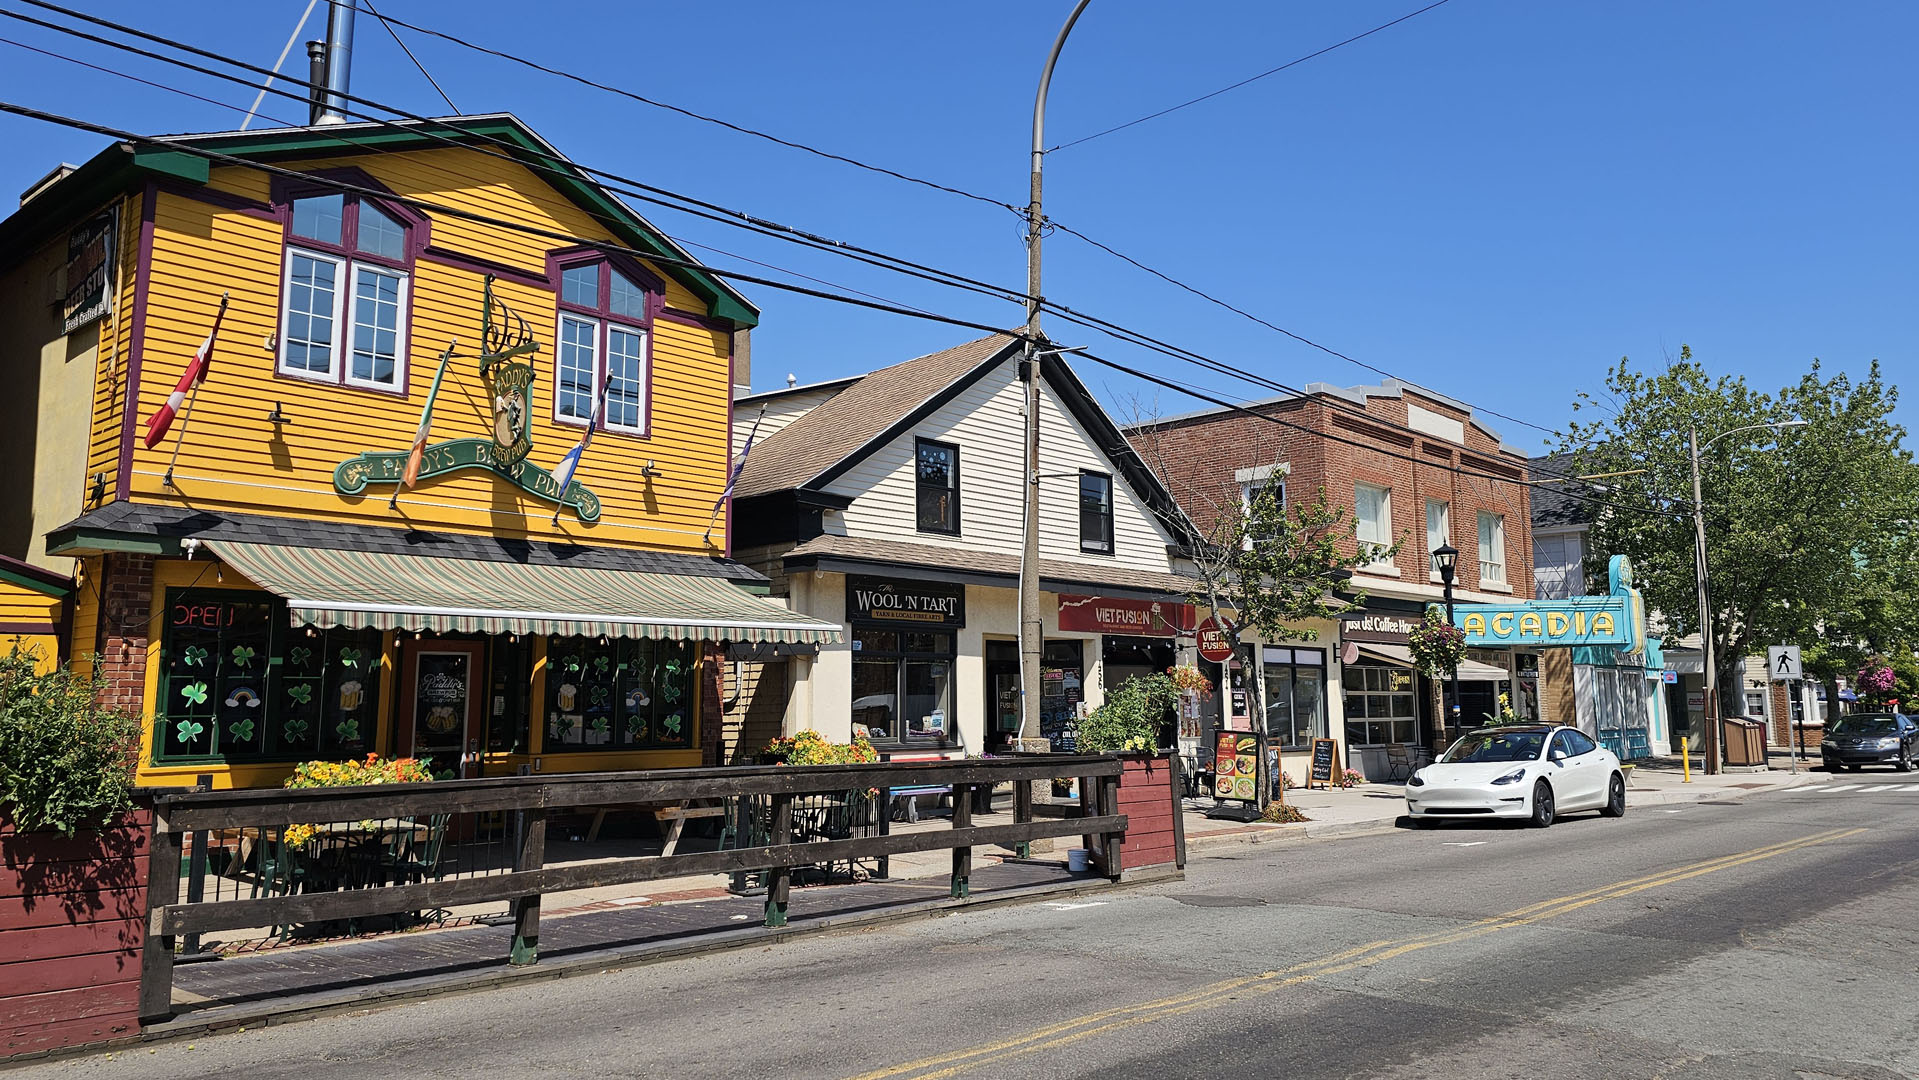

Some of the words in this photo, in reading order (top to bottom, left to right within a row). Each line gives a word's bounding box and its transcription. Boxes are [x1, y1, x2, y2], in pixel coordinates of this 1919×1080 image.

[65, 314, 79, 333] Fresh
[79, 303, 97, 325] Crafted
[496, 368, 530, 395] PADDY'S
[382, 447, 456, 478] PADY'S
[492, 443, 511, 463] BREW
[511, 438, 527, 460] PUB
[856, 590, 902, 611] WOOL
[905, 595, 918, 610] 'N
[921, 597, 957, 616] TART
[1095, 607, 1116, 623] VIET
[1116, 609, 1150, 624] FUSION
[1202, 631, 1220, 641] VIET
[1374, 616, 1398, 632] Coffee
[1463, 612, 1616, 637] ACADIA
[1202, 641, 1229, 650] FUSION
